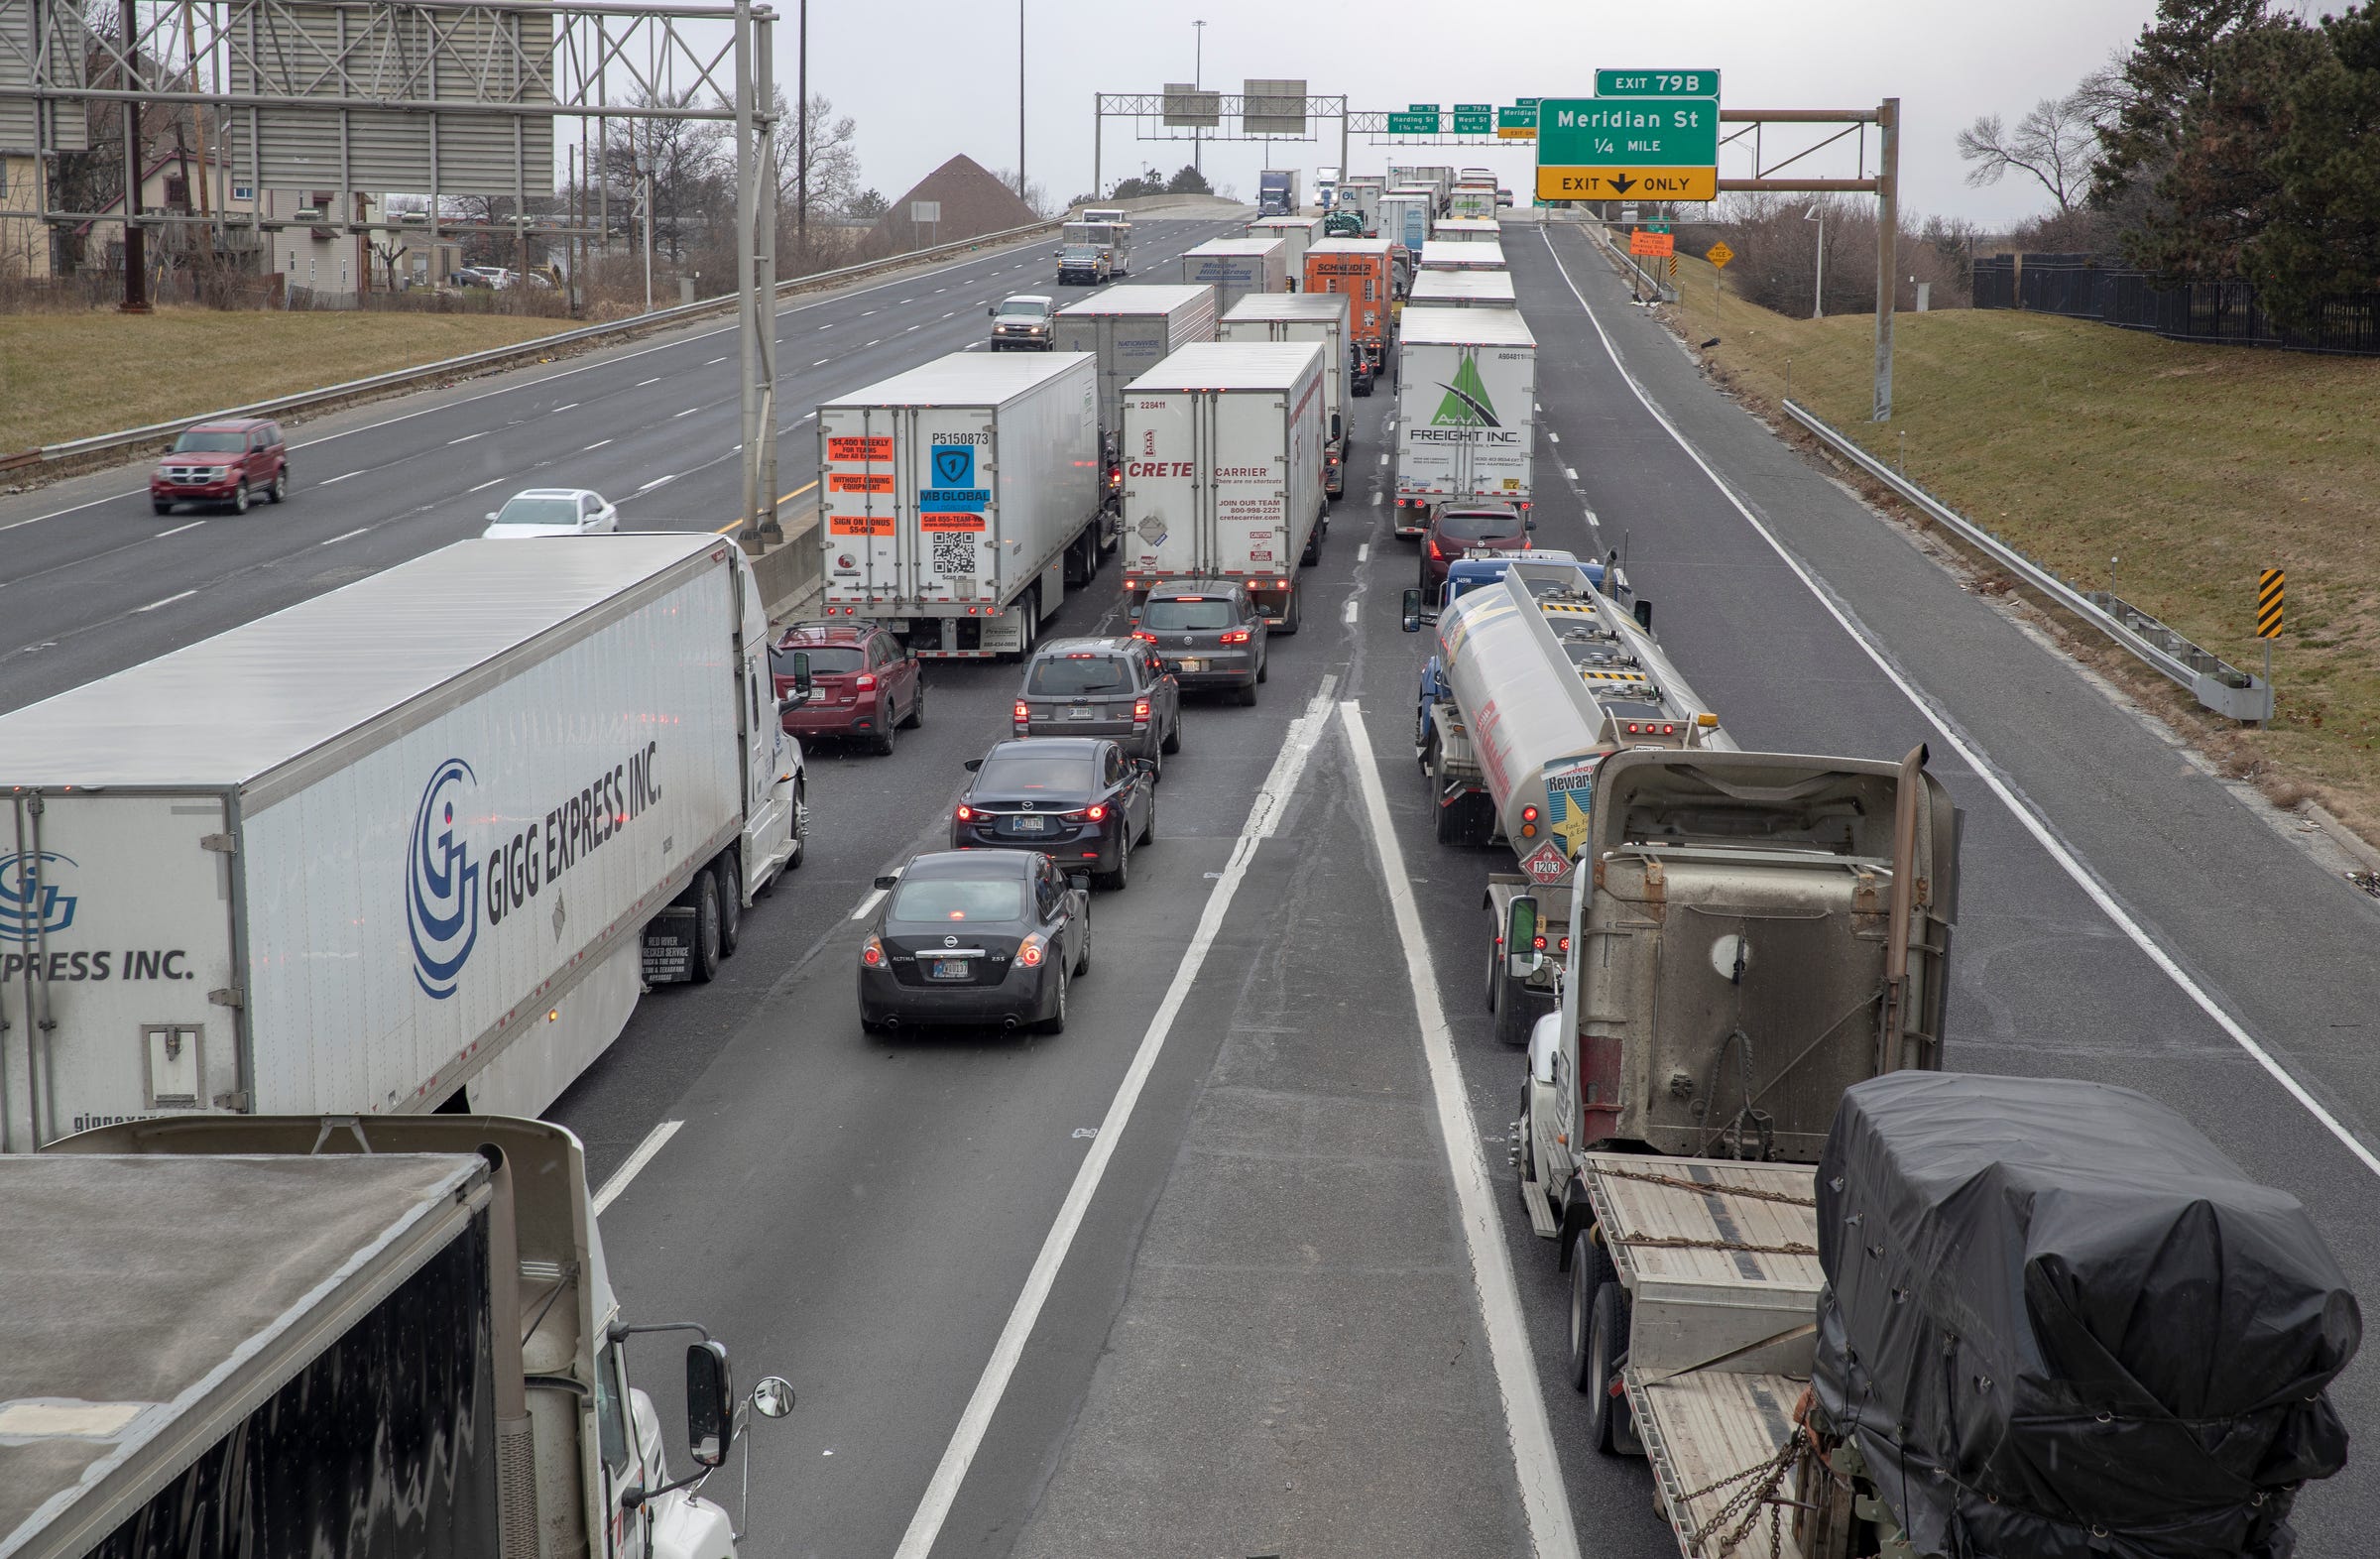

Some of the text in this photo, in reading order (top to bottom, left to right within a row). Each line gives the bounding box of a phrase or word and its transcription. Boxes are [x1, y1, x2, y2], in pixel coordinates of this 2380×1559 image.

[1615, 75, 1700, 91] EXIT 79B
[1558, 110, 1699, 128] Meridian St
[1627, 140, 1661, 152] MILE
[1562, 179, 1691, 191] EXIT ONLY
[1317, 263, 1371, 272] SCHNEIDER
[1140, 401, 1166, 410] 228411
[1437, 414, 1483, 424] AAA
[932, 432, 989, 445] P5150873
[1410, 429, 1521, 442] FREIGHT INC.
[1129, 462, 1194, 478] CRETE
[1215, 467, 1267, 477] CARRIER
[920, 491, 991, 501] MB GLOBAL
[1548, 774, 1593, 792] Rewar
[487, 823, 538, 926] GIGG
[546, 764, 625, 885] EXPRESS
[629, 741, 661, 822] INC.
[1535, 862, 1559, 873] 1203
[648, 936, 678, 946] RED RIVER
[643, 946, 689, 957] RECKER SERVICE
[0, 950, 194, 983] PRESS INC.
[74, 1113, 165, 1133] giggex
